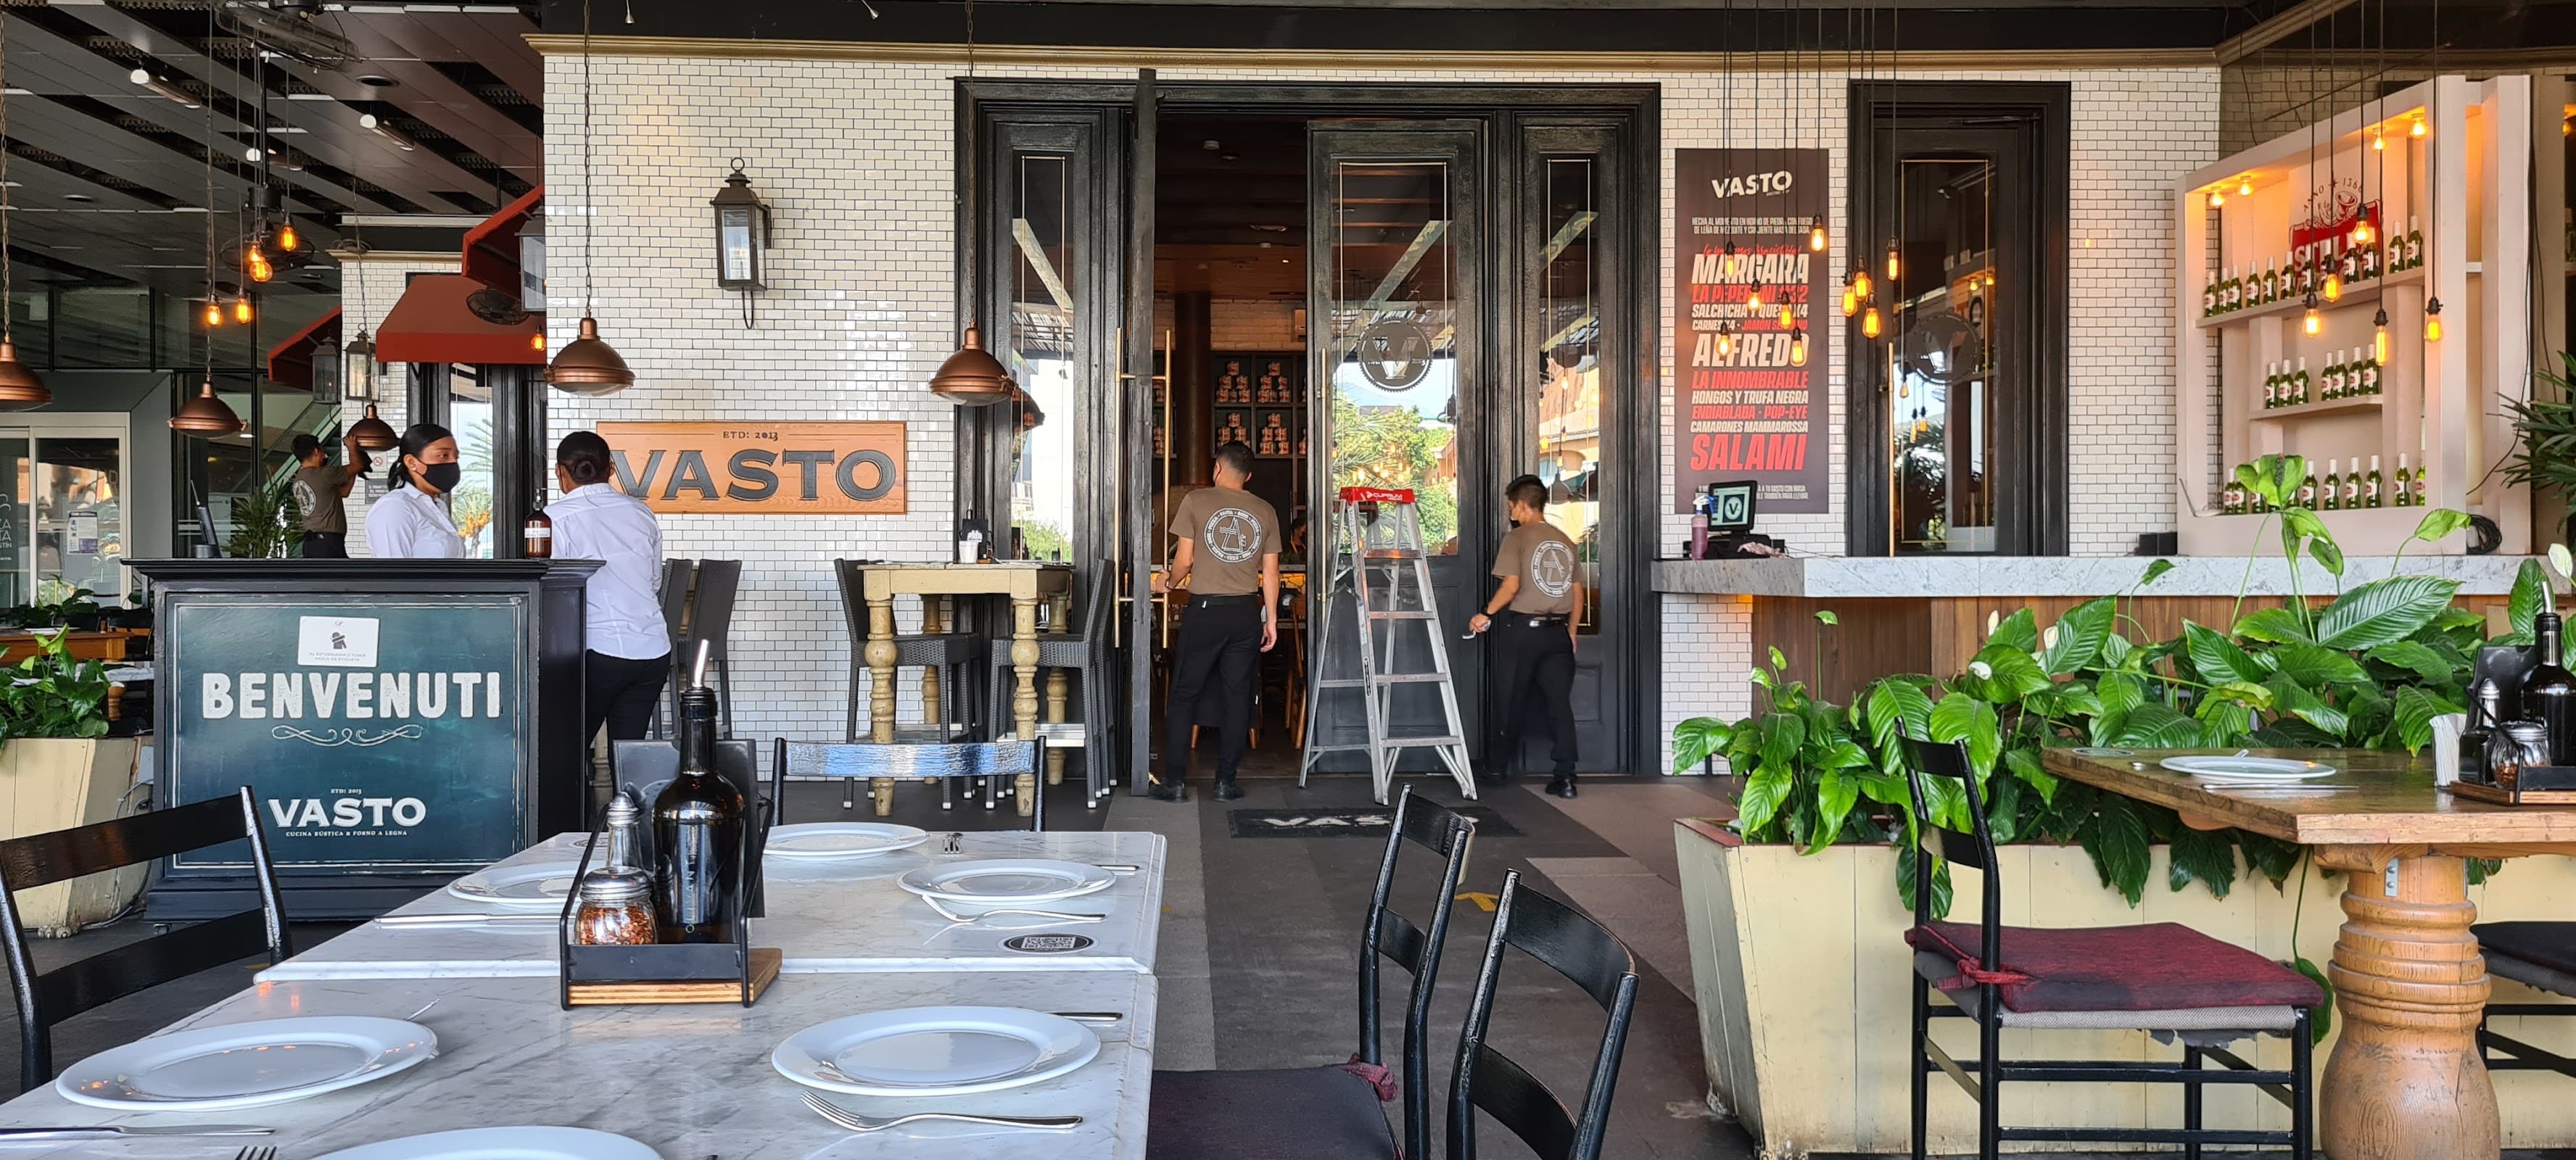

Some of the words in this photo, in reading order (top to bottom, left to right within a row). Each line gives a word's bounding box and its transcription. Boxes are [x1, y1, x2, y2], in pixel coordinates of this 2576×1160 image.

[1712, 170, 1792, 199] VASTO
[1691, 254, 1809, 284] MARGARA
[1692, 285, 1709, 303] LA
[1712, 285, 1776, 303] PEPERNI
[1692, 303, 1748, 318] SALCHICHA
[1692, 333, 1810, 368] ALFREDO
[1691, 370, 1709, 389] LA
[1711, 370, 1809, 389] INNOMBRABLE
[1691, 390, 1733, 405] HONGOS
[1734, 390, 1743, 405] Y
[1743, 390, 1774, 405] TRUFA
[1775, 390, 1809, 405] NEGRA
[1690, 420, 1743, 433] CAMARONES
[1743, 420, 1809, 434] MAMMAROSSA
[1691, 405, 1756, 420] ENDIABLADA
[1763, 405, 1808, 420] POP-EYE
[1690, 434, 1808, 471] SALAMI
[610, 448, 896, 502] VASTO
[202, 671, 501, 719] BENVENUTI
[267, 797, 427, 828] VASTO
